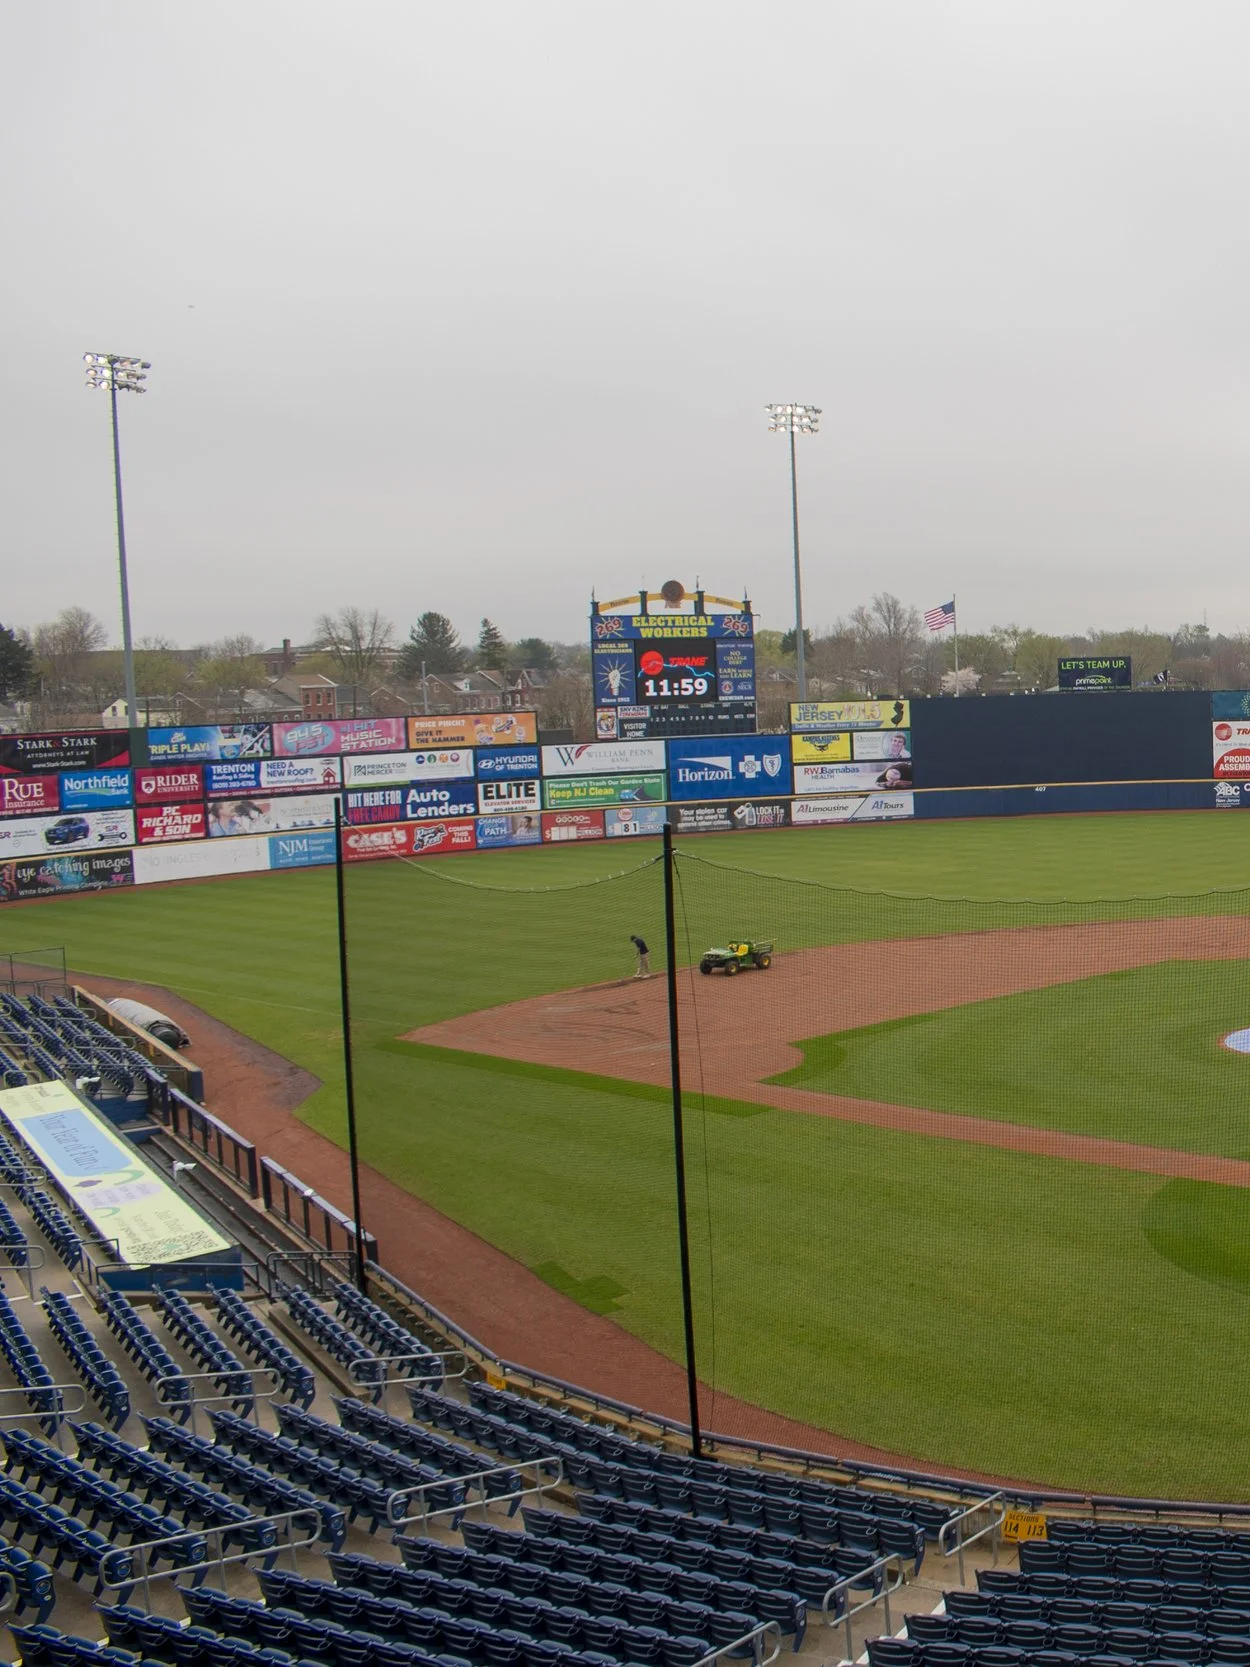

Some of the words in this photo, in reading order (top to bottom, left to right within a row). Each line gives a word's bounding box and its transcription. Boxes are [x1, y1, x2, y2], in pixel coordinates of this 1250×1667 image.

[632, 616, 714, 627] ELECTRICAL
[724, 618, 748, 633] 269
[596, 618, 622, 636] 269
[640, 628, 708, 638] WORKERS
[669, 656, 706, 666] TRANE
[1062, 661, 1084, 670] LET'S
[645, 678, 708, 696] 11:59
[798, 704, 818, 712] NEW
[796, 710, 843, 722] JERSEY
[624, 722, 646, 730] VISITOR
[340, 729, 382, 742] MUSIC
[17, 738, 54, 750] STARK
[62, 737, 98, 748] STARK
[340, 736, 396, 752] STATION
[586, 750, 627, 758] WILLIAM
[630, 748, 654, 756] PENN
[495, 755, 537, 764] HYUNDAI
[211, 764, 255, 774] TRENTON
[266, 762, 286, 770] NEED
[366, 762, 407, 770] PRINCETON
[506, 762, 538, 770] TRENTON
[804, 766, 860, 776] RWJBarnabas
[266, 770, 286, 778] NEW
[287, 768, 314, 777] ROOF?
[678, 768, 732, 782] Horizon
[64, 774, 129, 791] Northfield
[156, 773, 199, 786] RIDER
[3, 778, 44, 801] RUE
[157, 784, 199, 793] UNIVERSITY
[483, 782, 536, 800] ELITE
[550, 789, 572, 800] Keep
[574, 788, 586, 796] NJ
[588, 787, 614, 796] Clean
[1217, 786, 1240, 796] ABC
[348, 792, 362, 808] HIT
[363, 791, 384, 807] HERE
[385, 790, 402, 805] FOR
[406, 789, 450, 804] Auto
[4, 799, 45, 808] Insurance
[808, 803, 850, 813] Limousine
[884, 802, 904, 810] Tours
[162, 806, 181, 816] PC
[406, 802, 476, 818] Lenders
[680, 808, 694, 816] Your
[756, 806, 772, 815] LOCK
[142, 814, 202, 828] RICHARD
[757, 814, 775, 825] LOSE
[776, 813, 785, 824] IT
[154, 826, 163, 836] &
[165, 824, 192, 836] SON
[484, 826, 508, 836] PATH
[624, 822, 638, 832] 81
[279, 839, 308, 856] NJM
[40, 860, 90, 876] catching
[92, 857, 130, 872] images
[1009, 1513, 1040, 1522] SECTIONS
[1004, 1521, 1019, 1533] 114
[1027, 1525, 1044, 1536] 113
